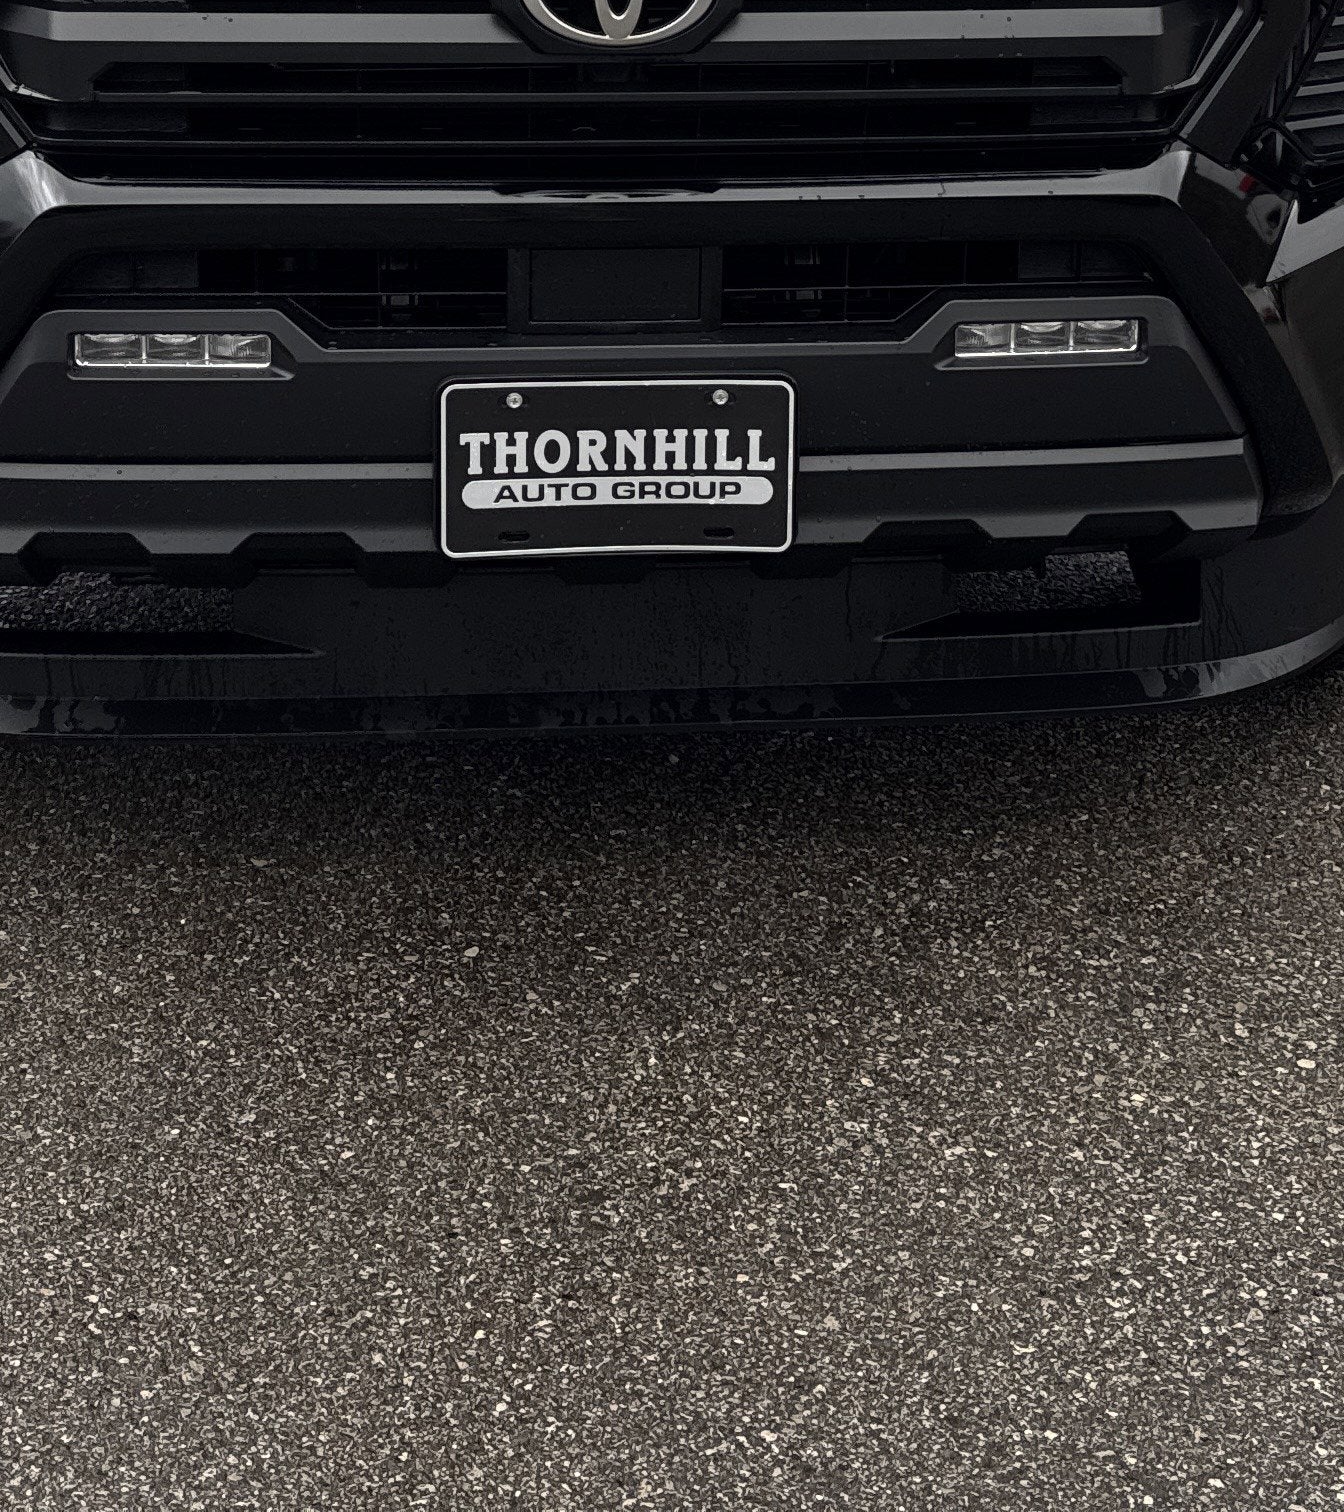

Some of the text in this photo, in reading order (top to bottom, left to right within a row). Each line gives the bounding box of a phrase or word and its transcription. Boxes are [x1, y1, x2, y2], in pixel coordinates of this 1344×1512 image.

[459, 428, 776, 475] THORNHILL
[493, 481, 742, 503] AUTO GROUP
